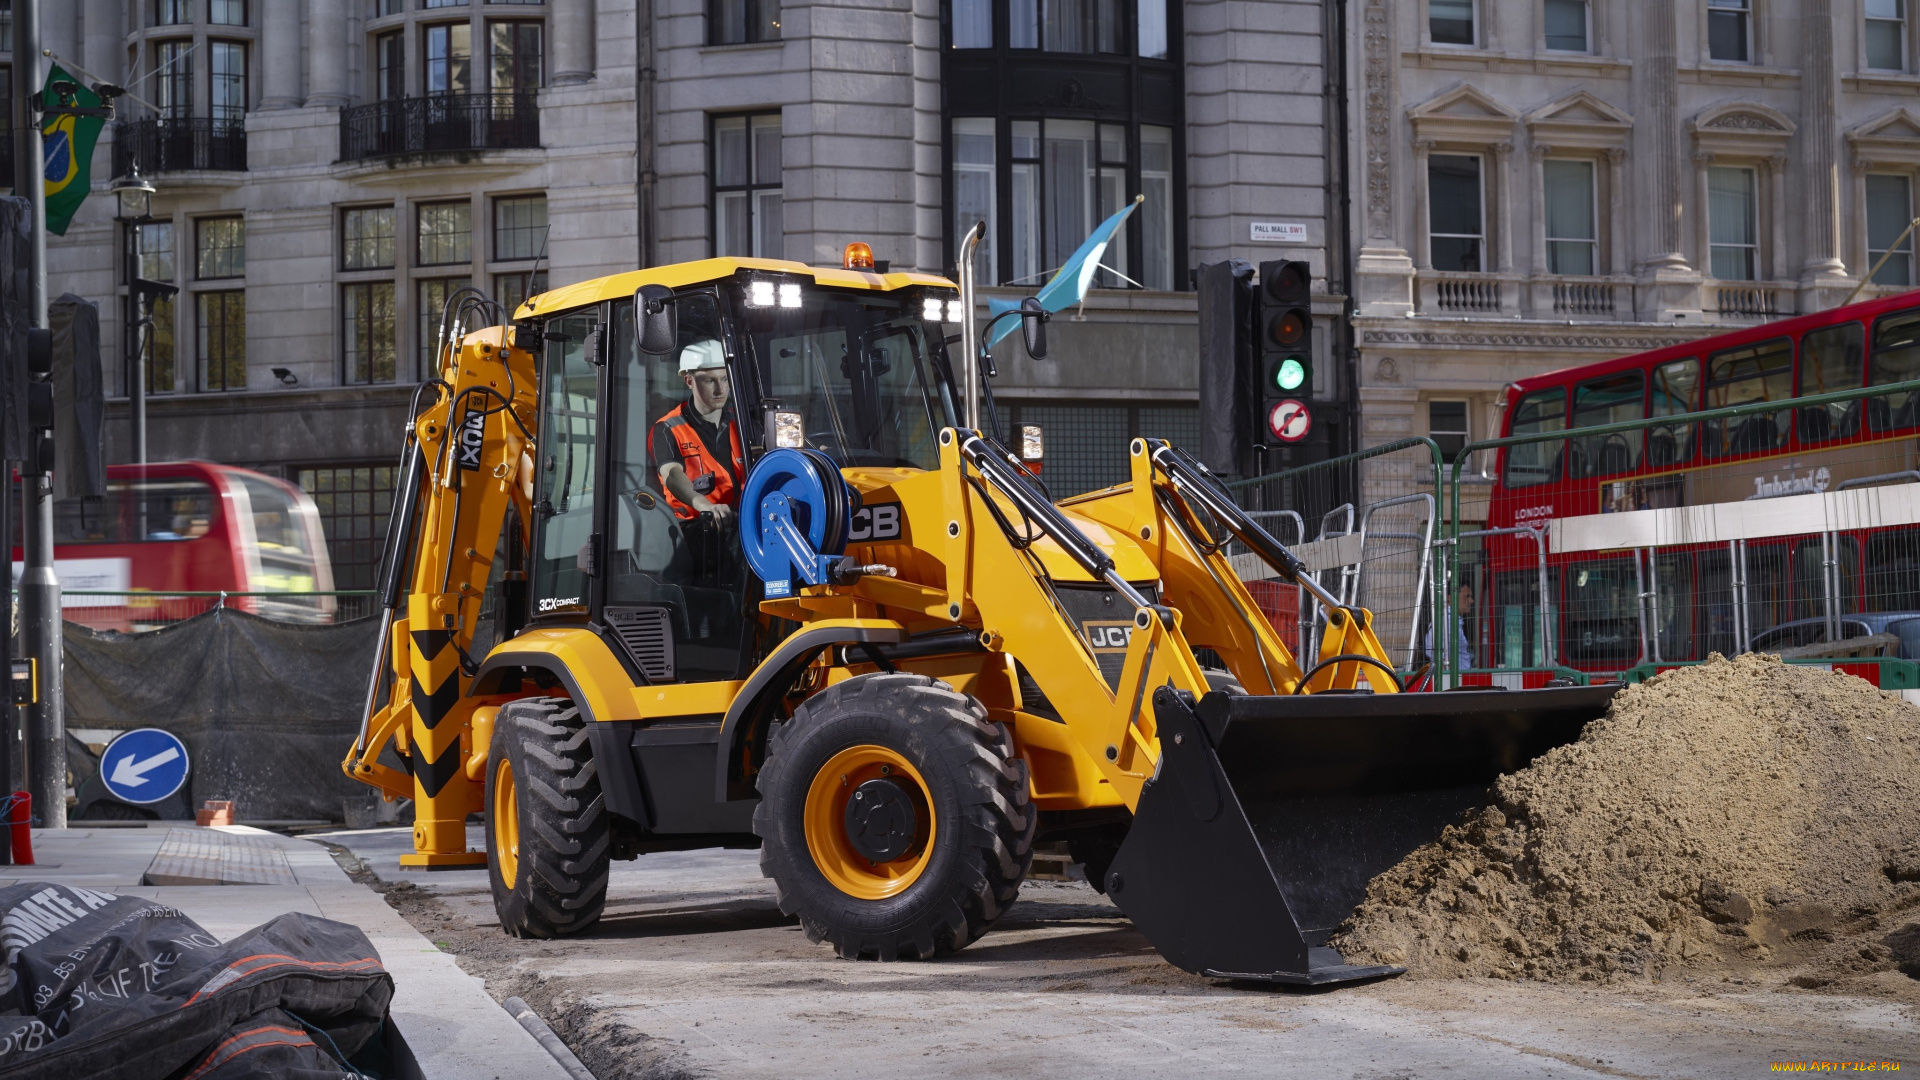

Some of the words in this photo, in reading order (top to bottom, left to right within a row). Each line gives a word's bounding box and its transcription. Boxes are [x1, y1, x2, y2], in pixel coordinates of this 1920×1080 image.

[1254, 225, 1269, 233] PALL
[1271, 226, 1288, 234] MALL
[1289, 226, 1303, 234] SW1
[1514, 505, 1553, 520] LONDON
[848, 505, 900, 540] CB
[539, 597, 557, 611] 3CX
[556, 597, 580, 607] COMPACT
[614, 612, 634, 621] JCB
[53, 961, 76, 980] BS
[97, 967, 131, 999] OF
